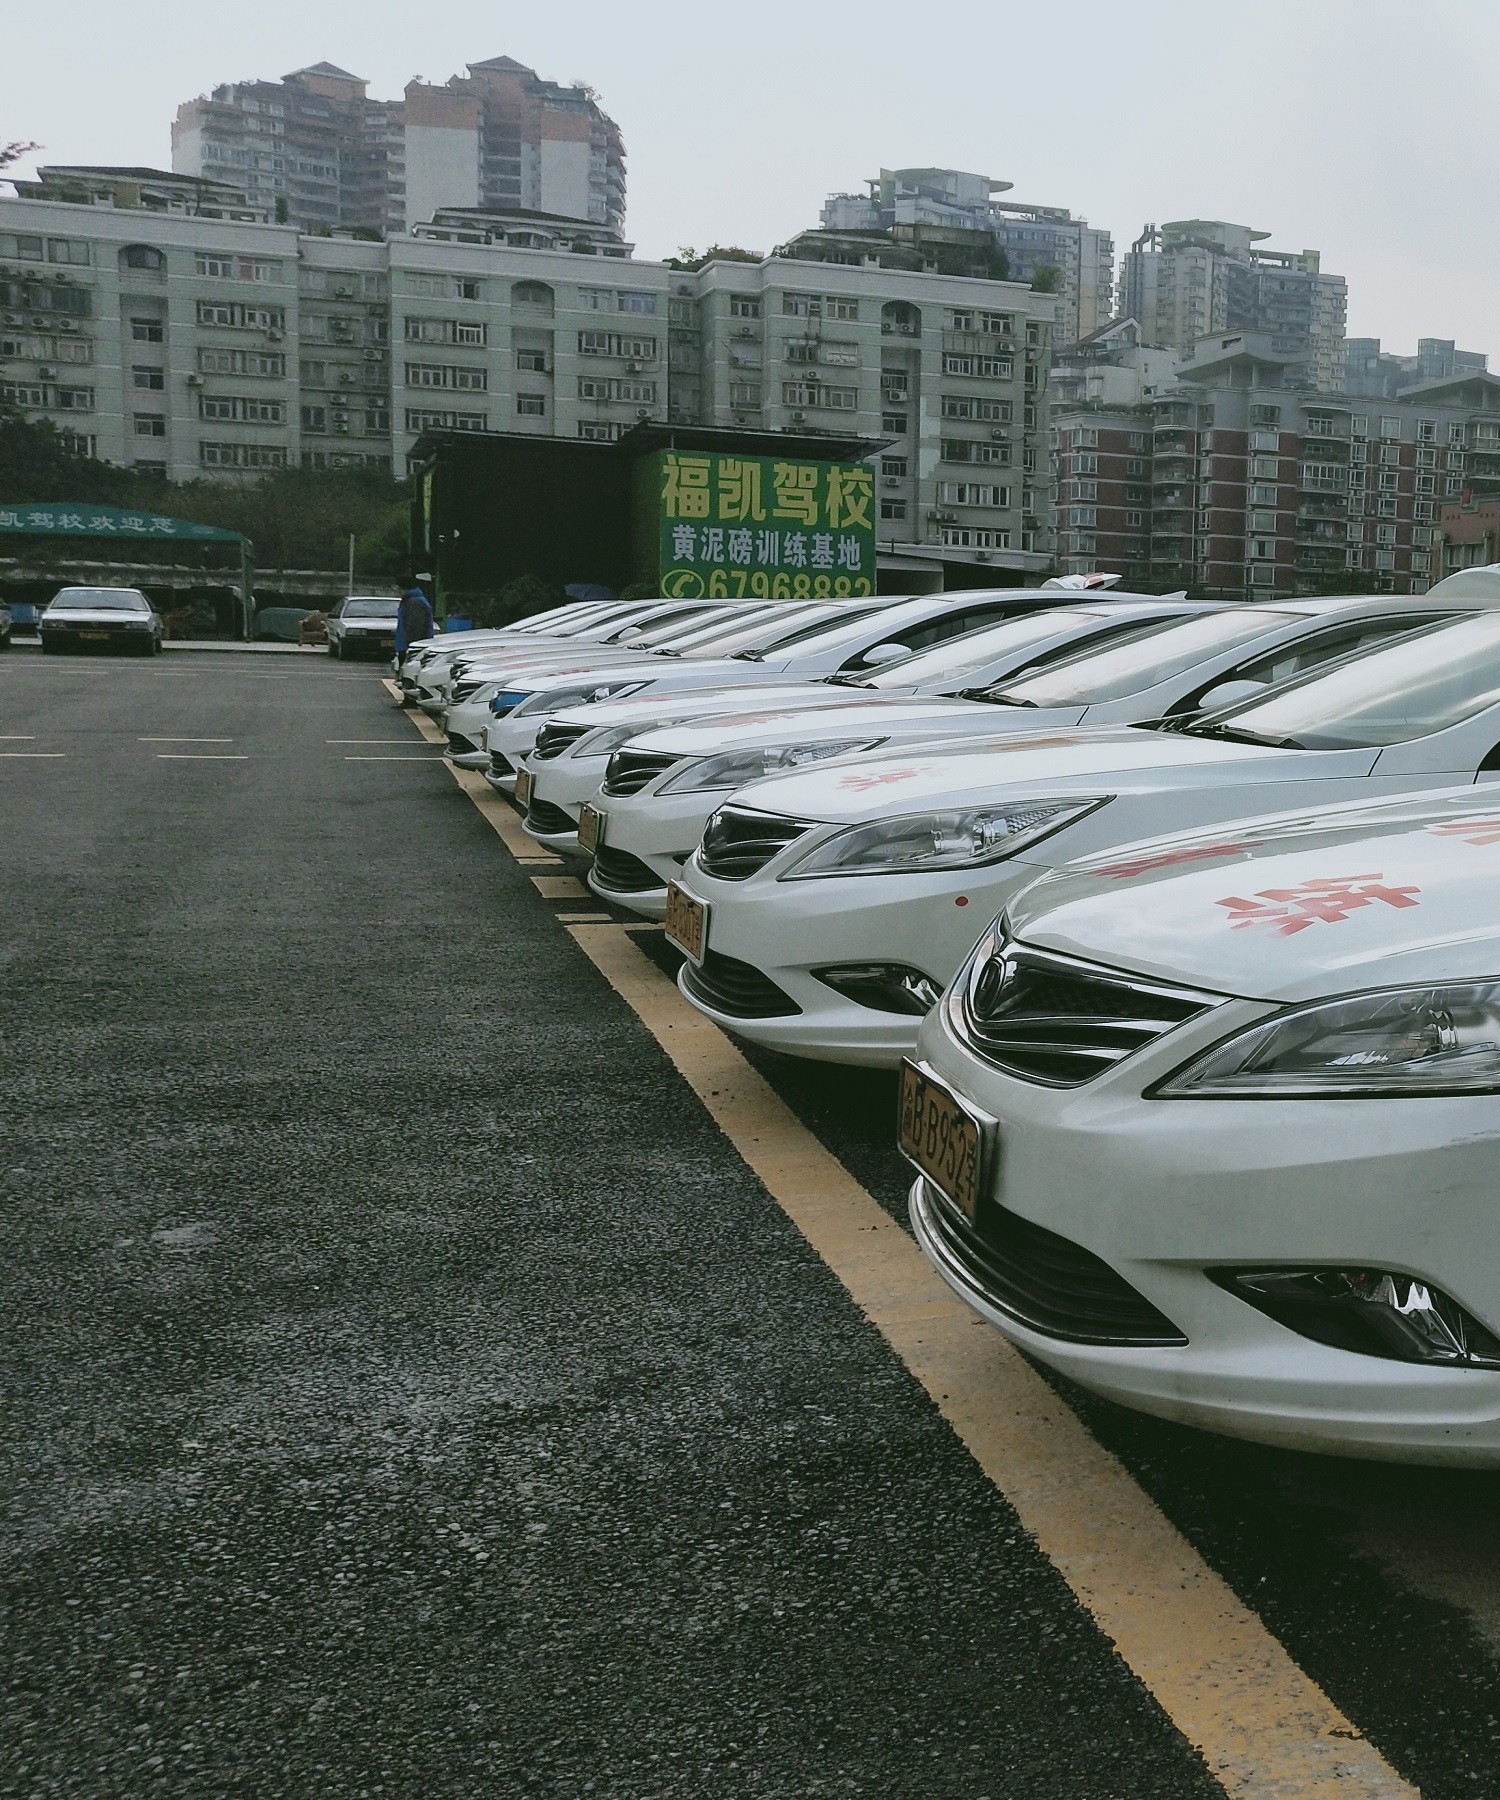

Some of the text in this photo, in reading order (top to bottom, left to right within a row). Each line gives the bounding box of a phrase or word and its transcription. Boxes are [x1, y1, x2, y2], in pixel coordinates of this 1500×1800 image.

[661, 454, 872, 529] 福凯驾校
[672, 523, 862, 571] 黄泥磅训练基地
